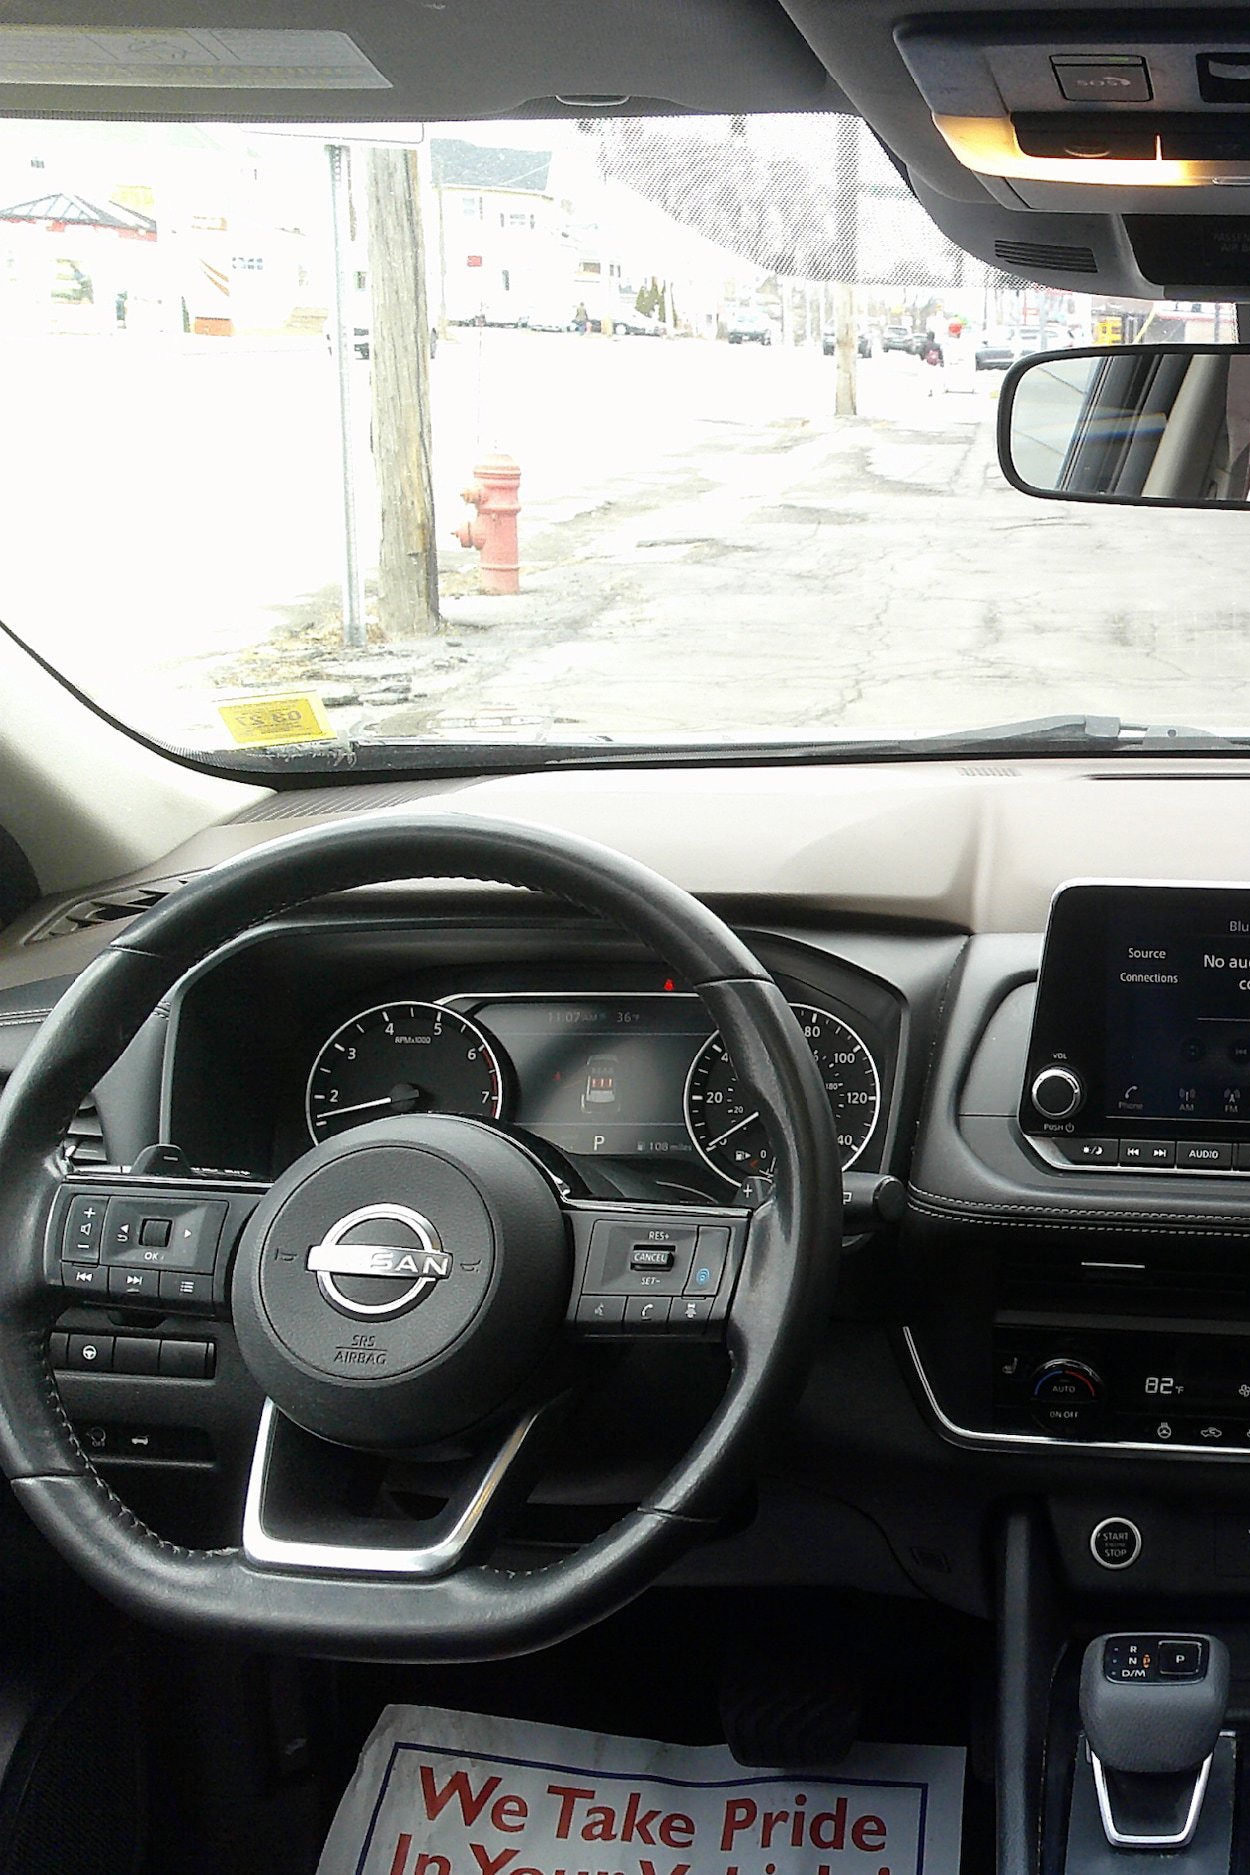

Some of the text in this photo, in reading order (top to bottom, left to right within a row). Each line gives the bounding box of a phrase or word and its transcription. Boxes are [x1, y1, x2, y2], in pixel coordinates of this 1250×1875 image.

[1128, 947, 1167, 959] Source
[1203, 954, 1225, 969] No
[1119, 972, 1179, 983] Connections
[384, 1022, 394, 1036] 4
[433, 1022, 443, 1036] 5
[804, 1026, 821, 1038] 80
[346, 1047, 357, 1061] 3
[467, 1047, 477, 1061] 6
[720, 1052, 730, 1063] 4
[833, 1052, 856, 1064] 100
[1052, 1052, 1068, 1060] VOL
[328, 1089, 339, 1103] 2
[481, 1090, 490, 1104] 7
[705, 1091, 724, 1104] 20
[846, 1091, 868, 1105] 120
[733, 1105, 744, 1114] 20
[1118, 1101, 1144, 1110] Phone
[1178, 1103, 1195, 1112] AM
[1224, 1104, 1239, 1113] FM
[1043, 1123, 1064, 1131] PUSH
[593, 1135, 605, 1151] P
[836, 1134, 853, 1146] 40
[1188, 1149, 1219, 1160] AUDIO
[648, 1231, 670, 1241] RES+
[144, 1251, 159, 1261] OK
[633, 1252, 668, 1263] CANCEL
[351, 1334, 376, 1347] SRS
[333, 1351, 387, 1364] AIRBAG
[1051, 1385, 1076, 1393] AUTO
[1102, 1532, 1129, 1541] START
[1104, 1548, 1127, 1558] STOP
[1129, 1645, 1138, 1653] R
[1128, 1657, 1138, 1665] N
[1175, 1654, 1186, 1664] P
[1121, 1669, 1147, 1678] D/M
[419, 1765, 887, 1853] We Take Pride
